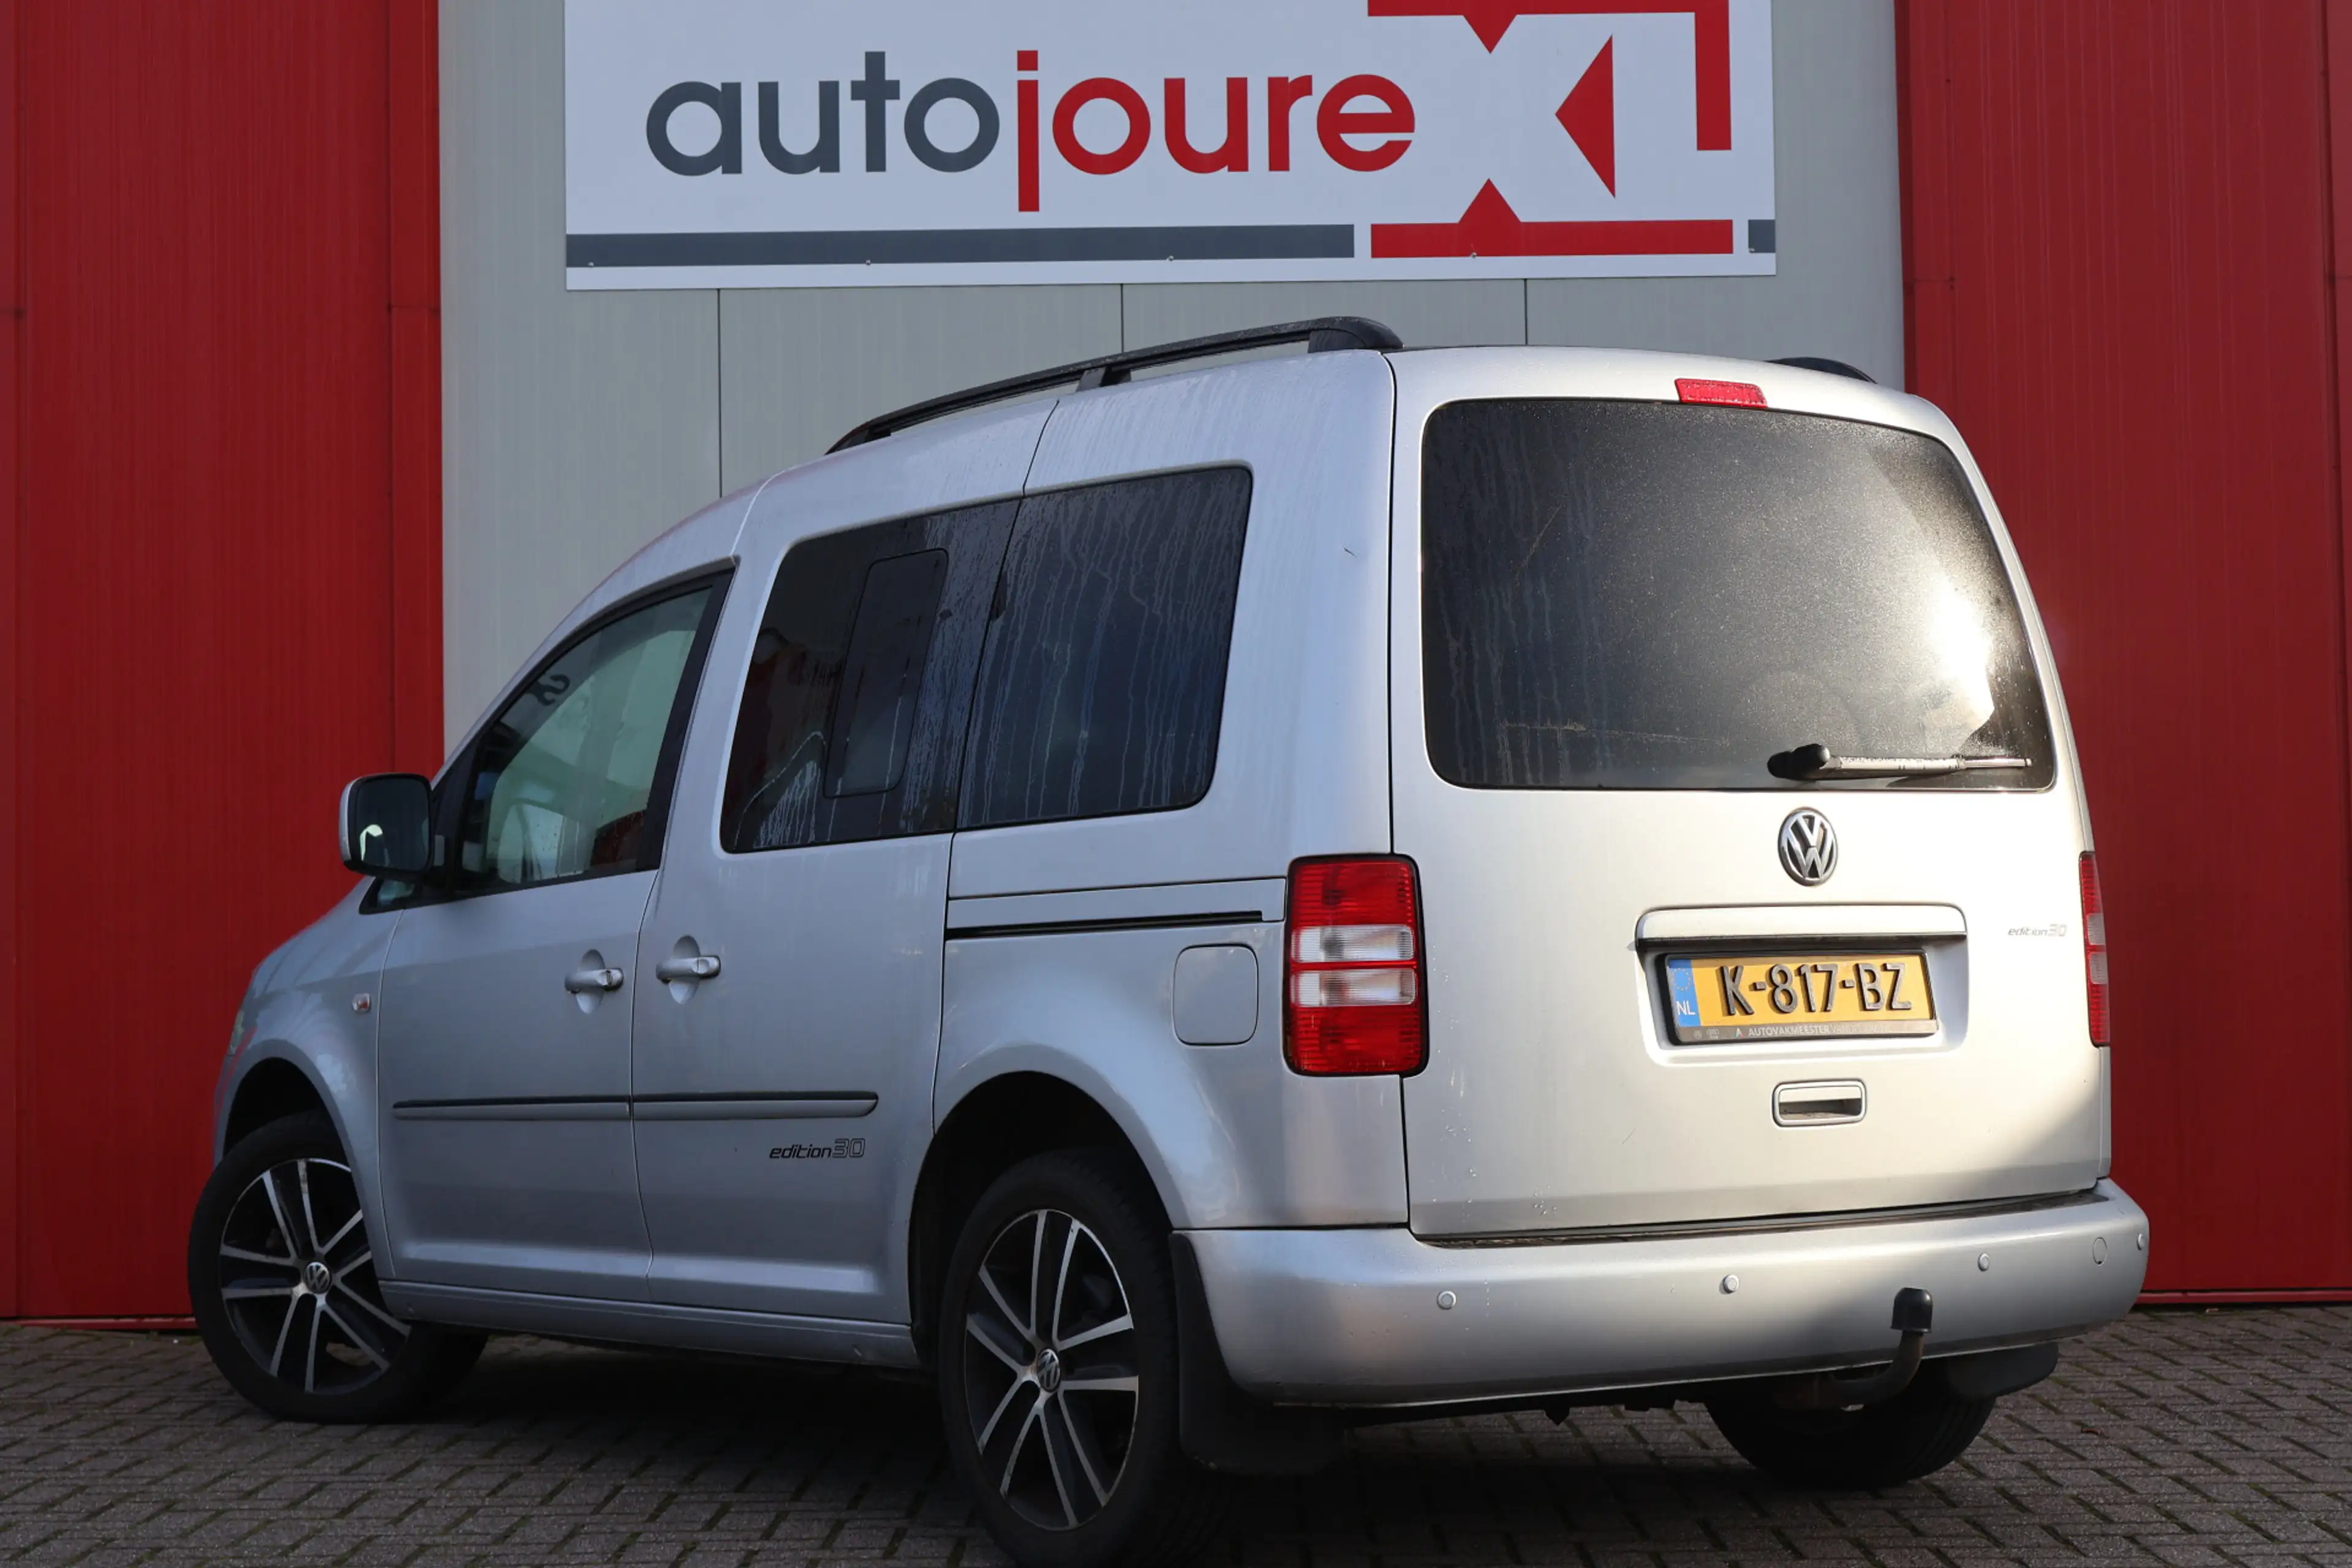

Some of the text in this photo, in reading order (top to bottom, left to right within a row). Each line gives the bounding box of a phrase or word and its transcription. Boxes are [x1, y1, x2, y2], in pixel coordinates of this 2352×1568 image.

[646, 50, 1415, 212] autojoure
[1717, 963, 1912, 1016] K-817-BZ
[1676, 1000, 1695, 1016] NL
[1748, 1025, 1829, 1037] AUTOVAKMEESTER
